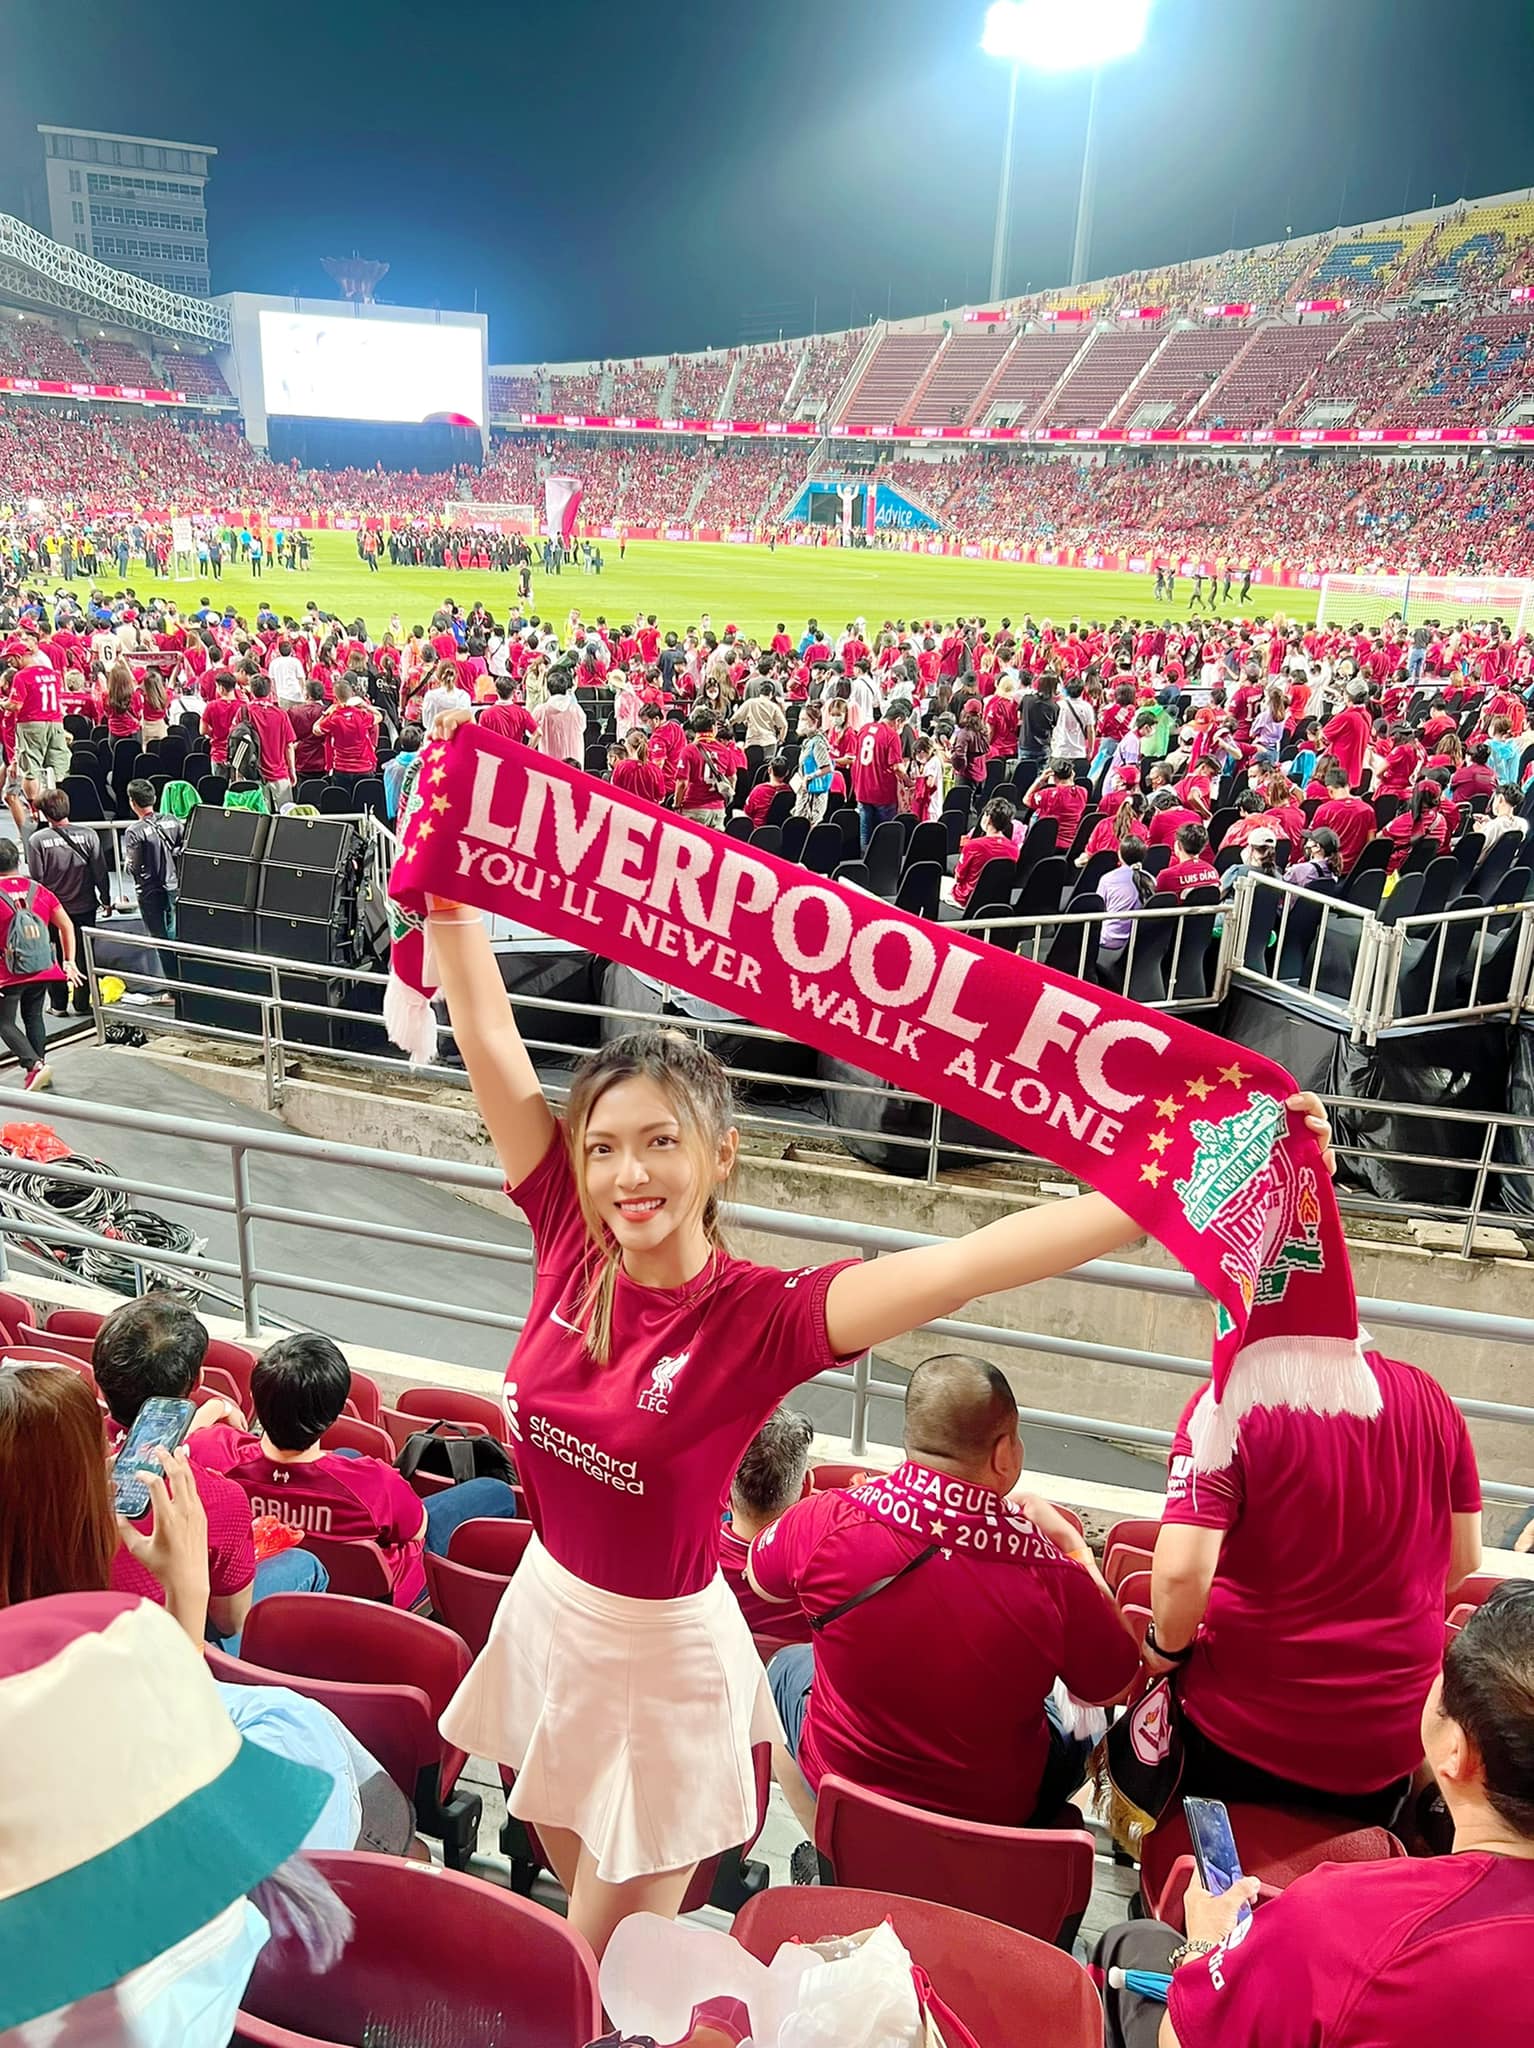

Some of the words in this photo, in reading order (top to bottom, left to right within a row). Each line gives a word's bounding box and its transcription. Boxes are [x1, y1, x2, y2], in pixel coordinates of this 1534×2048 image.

[104, 645, 113, 660] 6
[40, 683, 57, 712] 11
[861, 734, 875, 766] 8
[1180, 873, 1198, 885] LUIS
[461, 749, 988, 1042] LIVERPOOL
[1006, 982, 1172, 1113] FC
[456, 839, 602, 925] YOU'LL
[620, 907, 762, 993] NEVER
[789, 974, 927, 1061] WALK
[943, 1048, 1124, 1156] ALONE
[1215, 1159, 1252, 1196] NEVER
[529, 1415, 637, 1479] standard
[530, 1433, 644, 1495] chartered
[905, 1465, 999, 1516] LEAGUE
[251, 1496, 332, 1532] ARWIN
